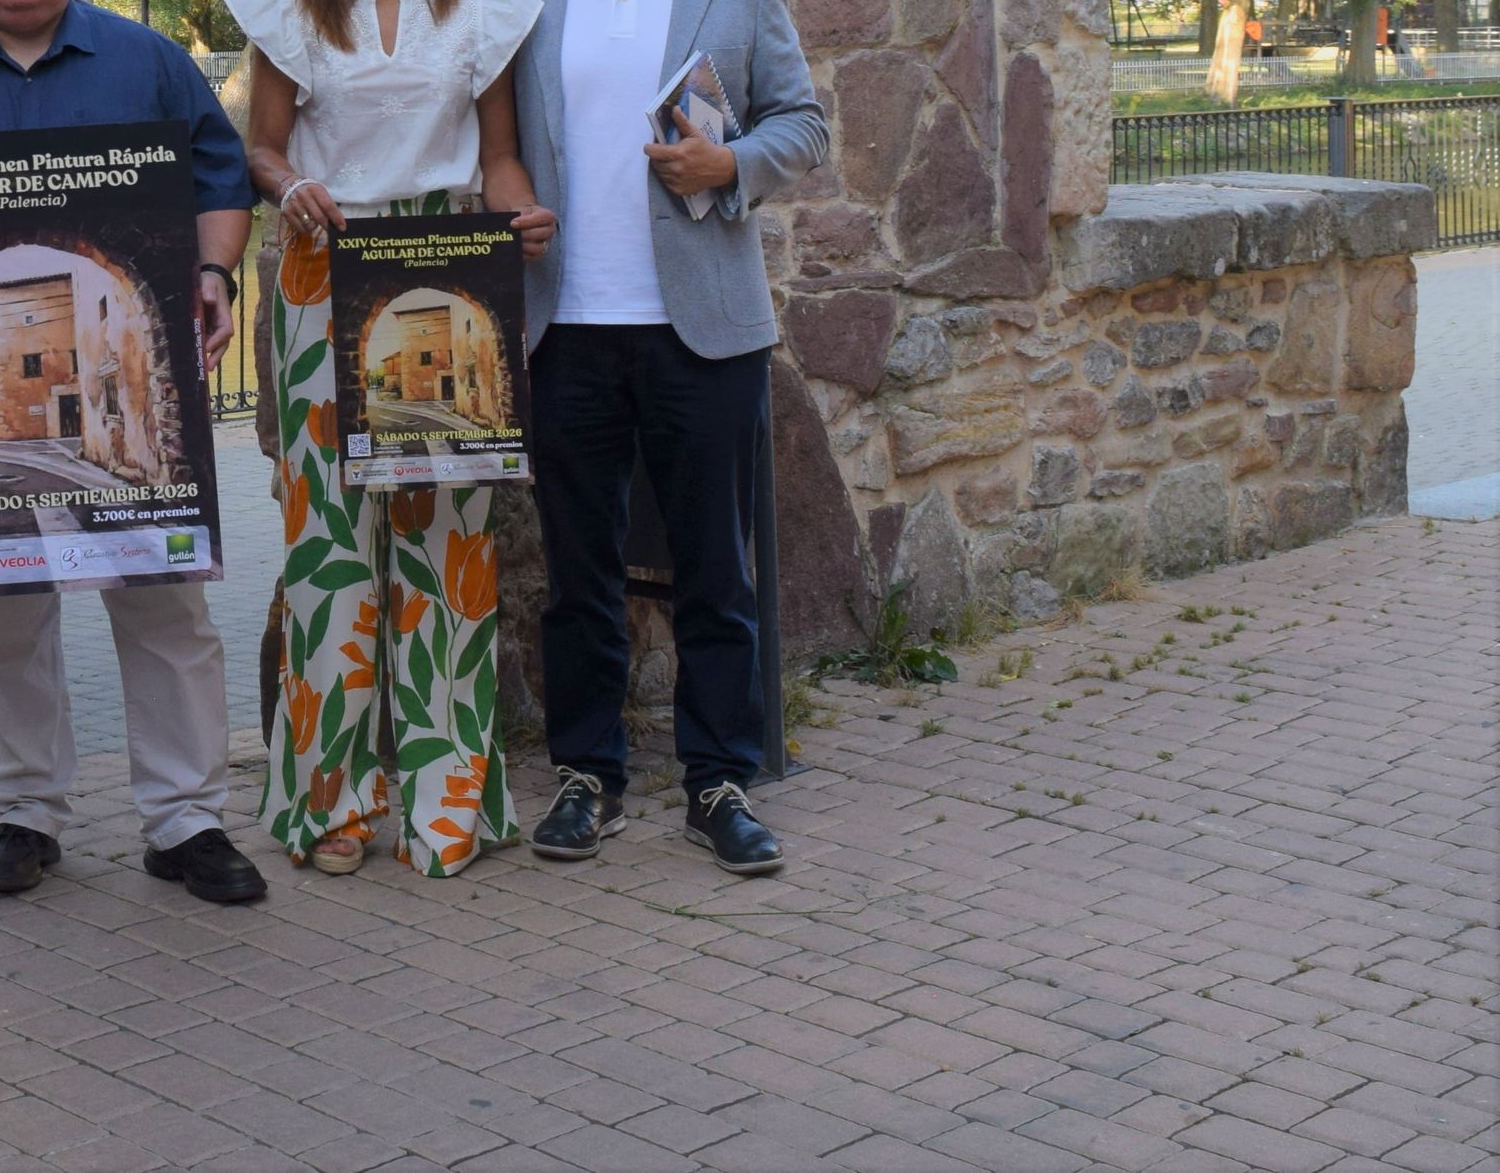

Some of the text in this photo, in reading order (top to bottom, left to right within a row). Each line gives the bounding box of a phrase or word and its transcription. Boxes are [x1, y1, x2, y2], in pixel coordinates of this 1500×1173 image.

[32, 153, 105, 171] Pintura
[108, 145, 176, 168] Rápida
[16, 176, 44, 193] DE
[47, 169, 138, 191] CAMPOO
[337, 231, 514, 250] XXIV Certamen Pintura Rápida
[361, 244, 491, 261] AGUILAR DE CAMPOO
[404, 258, 449, 268] (Palencia)
[376, 428, 523, 442] SÁBADO 5 SEPTIEMBRE 2026
[26, 494, 36, 509] 5
[38, 487, 151, 508] SEPTIEMBRE
[153, 483, 198, 500] 2026
[92, 505, 200, 522] 3.700€ en premios
[0, 556, 47, 568] VEOLIA
[168, 550, 195, 563] gullón
